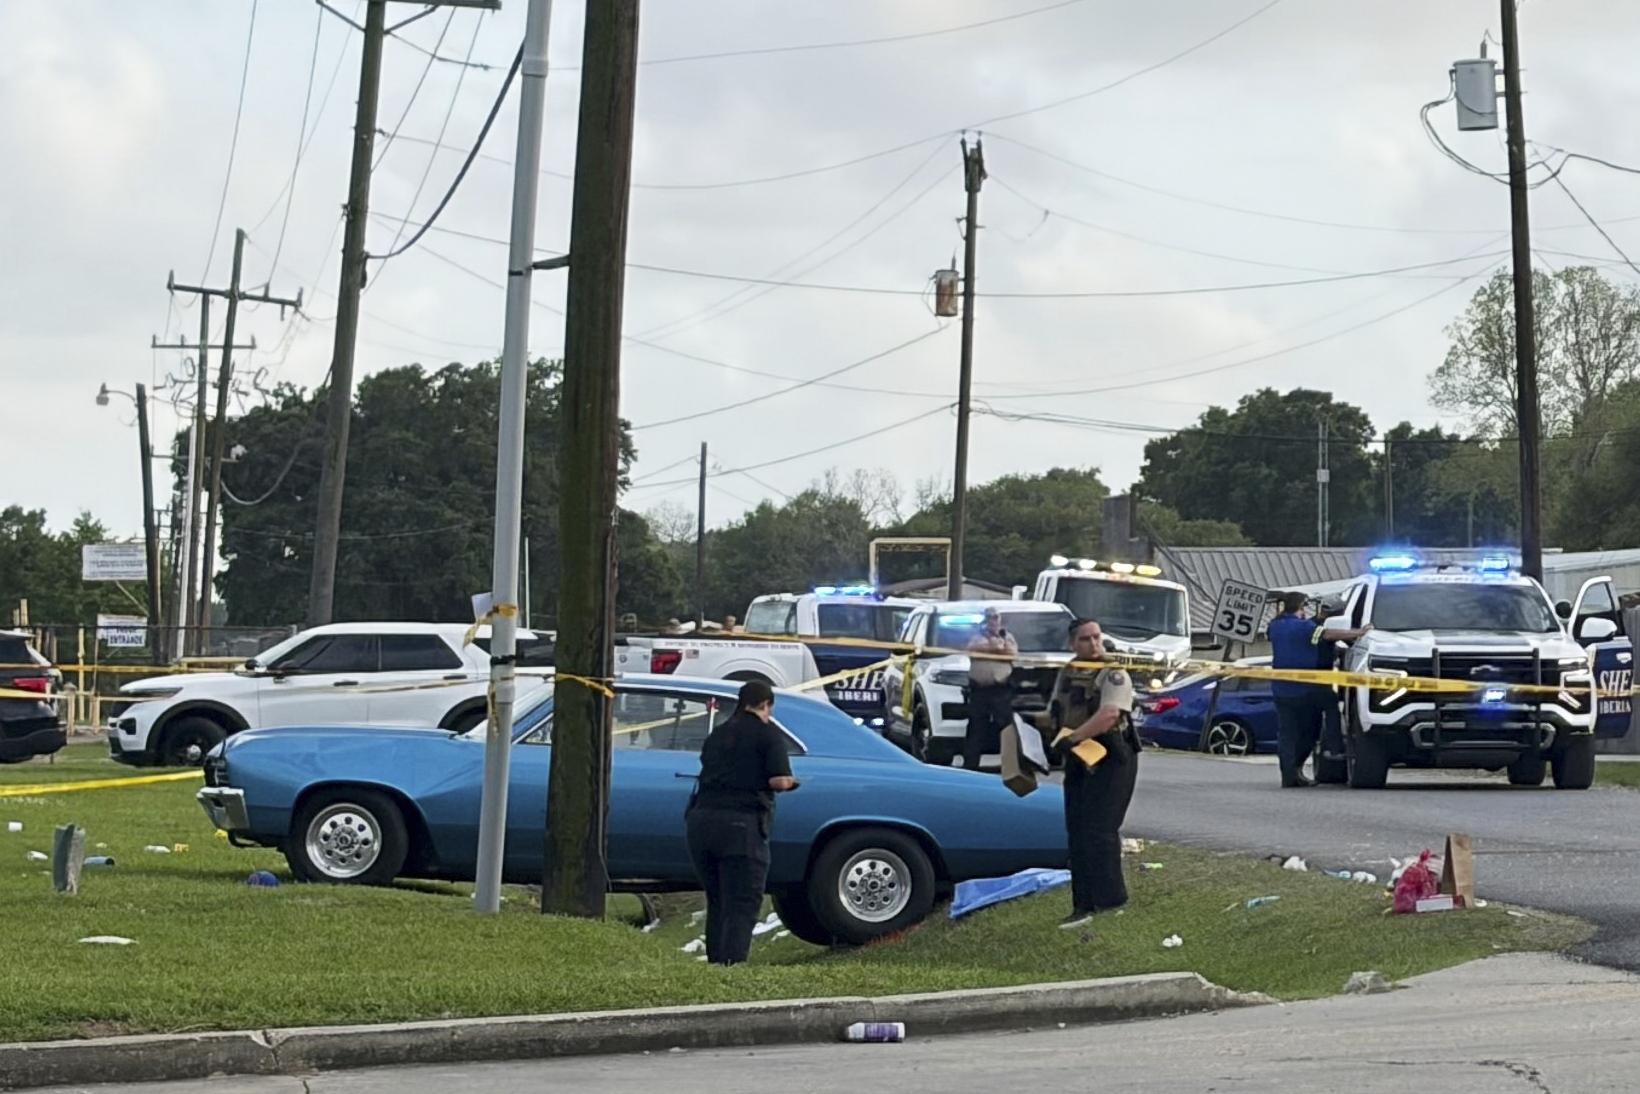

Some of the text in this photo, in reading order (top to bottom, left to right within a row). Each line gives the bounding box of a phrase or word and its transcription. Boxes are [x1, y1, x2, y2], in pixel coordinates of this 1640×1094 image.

[1225, 585, 1263, 604] SPEED
[1226, 598, 1257, 613] LIMIT
[1217, 609, 1254, 636] 35
[1599, 699, 1632, 715] IBERIA
